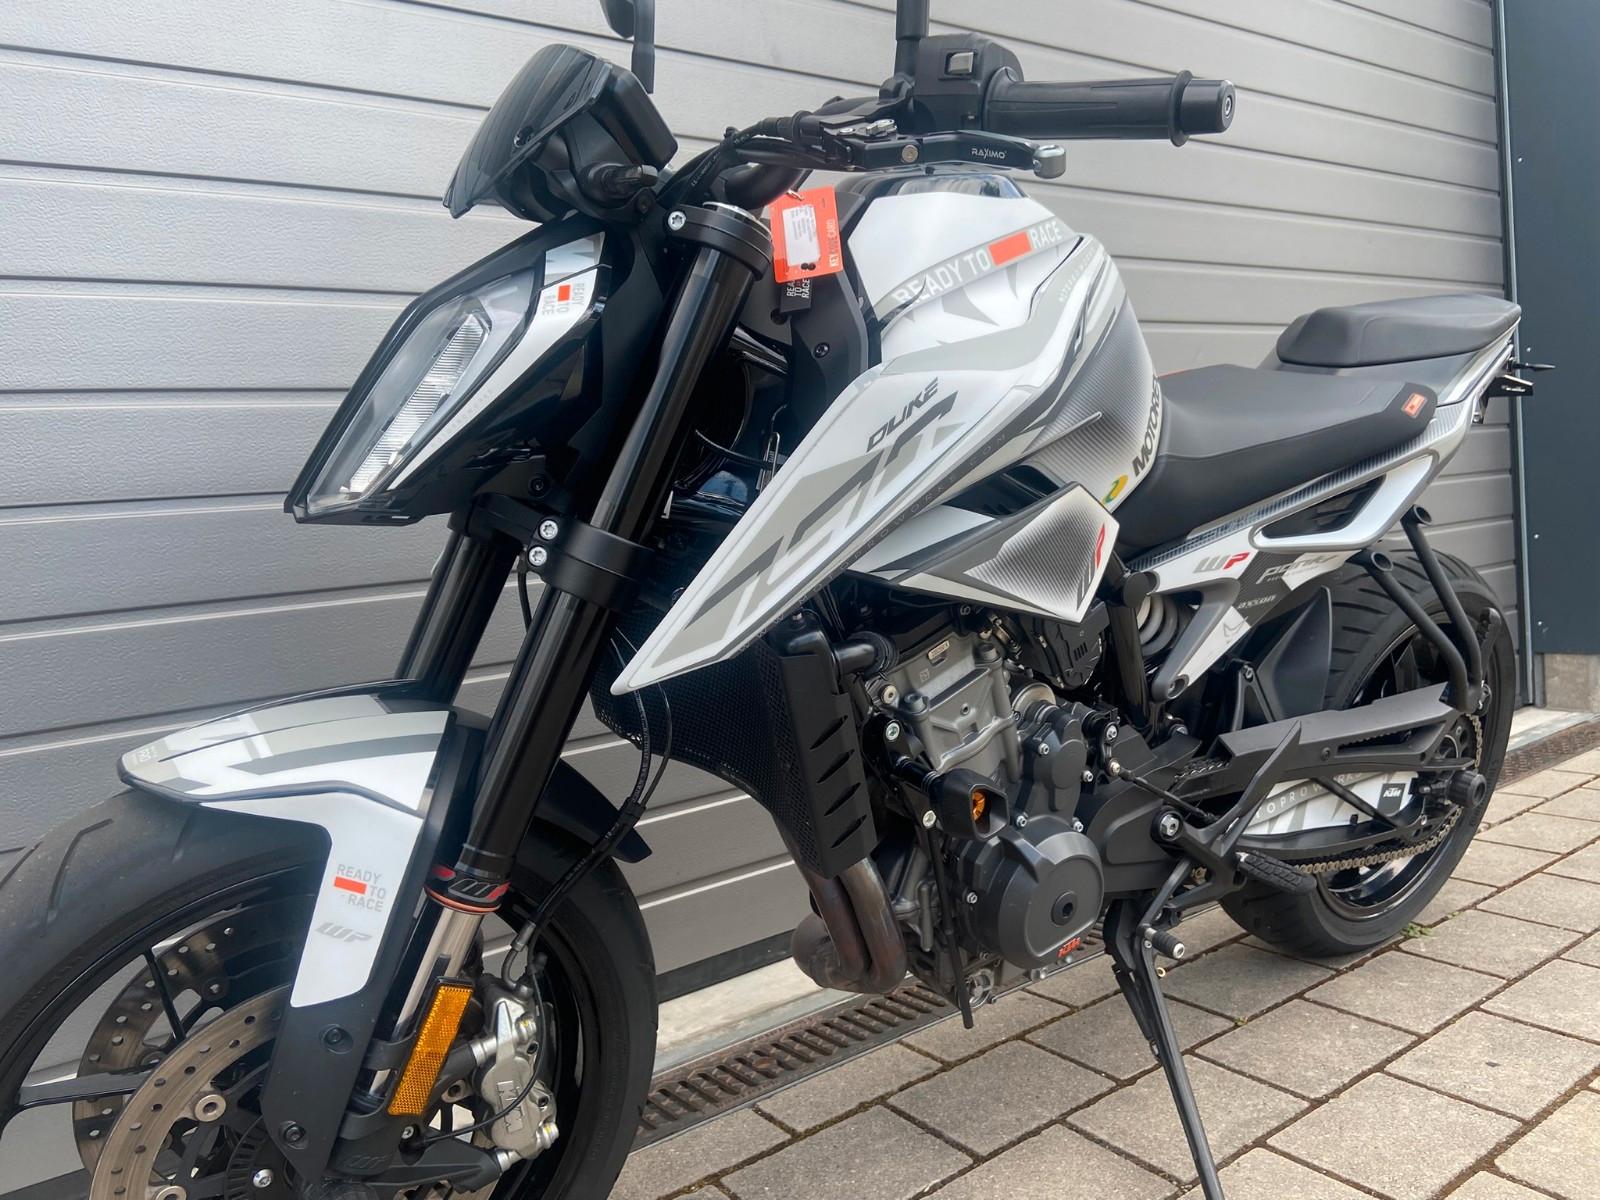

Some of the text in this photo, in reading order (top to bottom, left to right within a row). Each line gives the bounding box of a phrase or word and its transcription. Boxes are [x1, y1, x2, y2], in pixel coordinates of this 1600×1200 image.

[890, 219, 1065, 304] READY TO RACE
[866, 377, 939, 453] DUKE
[1193, 551, 1250, 574] WP
[1382, 786, 1402, 798] KTM
[336, 863, 383, 885] READY
[347, 895, 385, 912] RACE
[370, 885, 387, 900] TO
